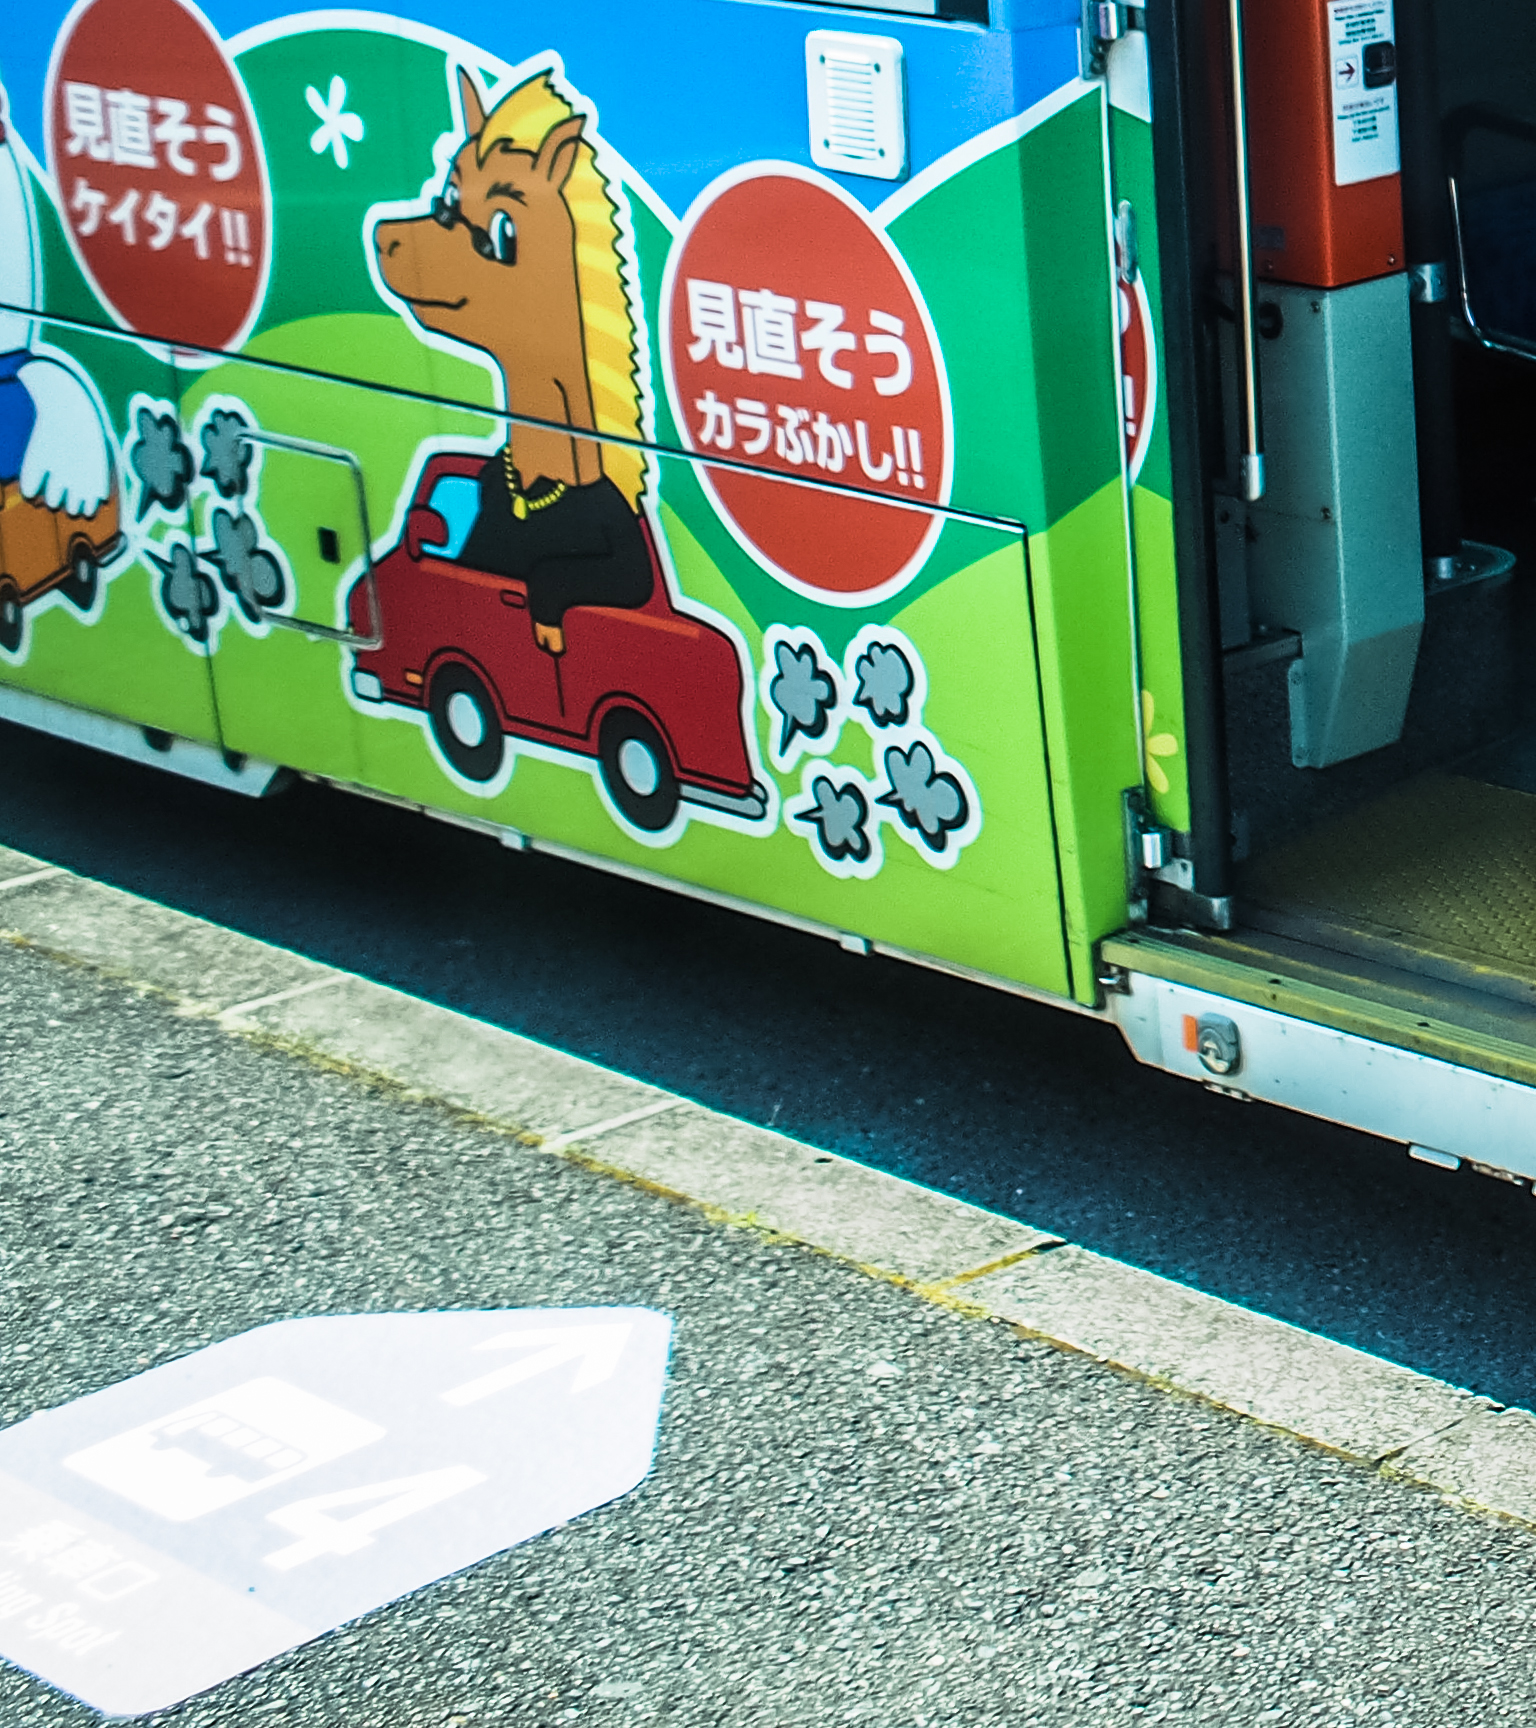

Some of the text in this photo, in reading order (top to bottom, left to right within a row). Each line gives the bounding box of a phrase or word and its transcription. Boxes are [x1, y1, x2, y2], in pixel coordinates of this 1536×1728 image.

[63, 81, 242, 182] 見直そう
[686, 278, 914, 397] 見直そう
[262, 1464, 488, 1571] 4
[0, 1569, 125, 1658] ing Spot
